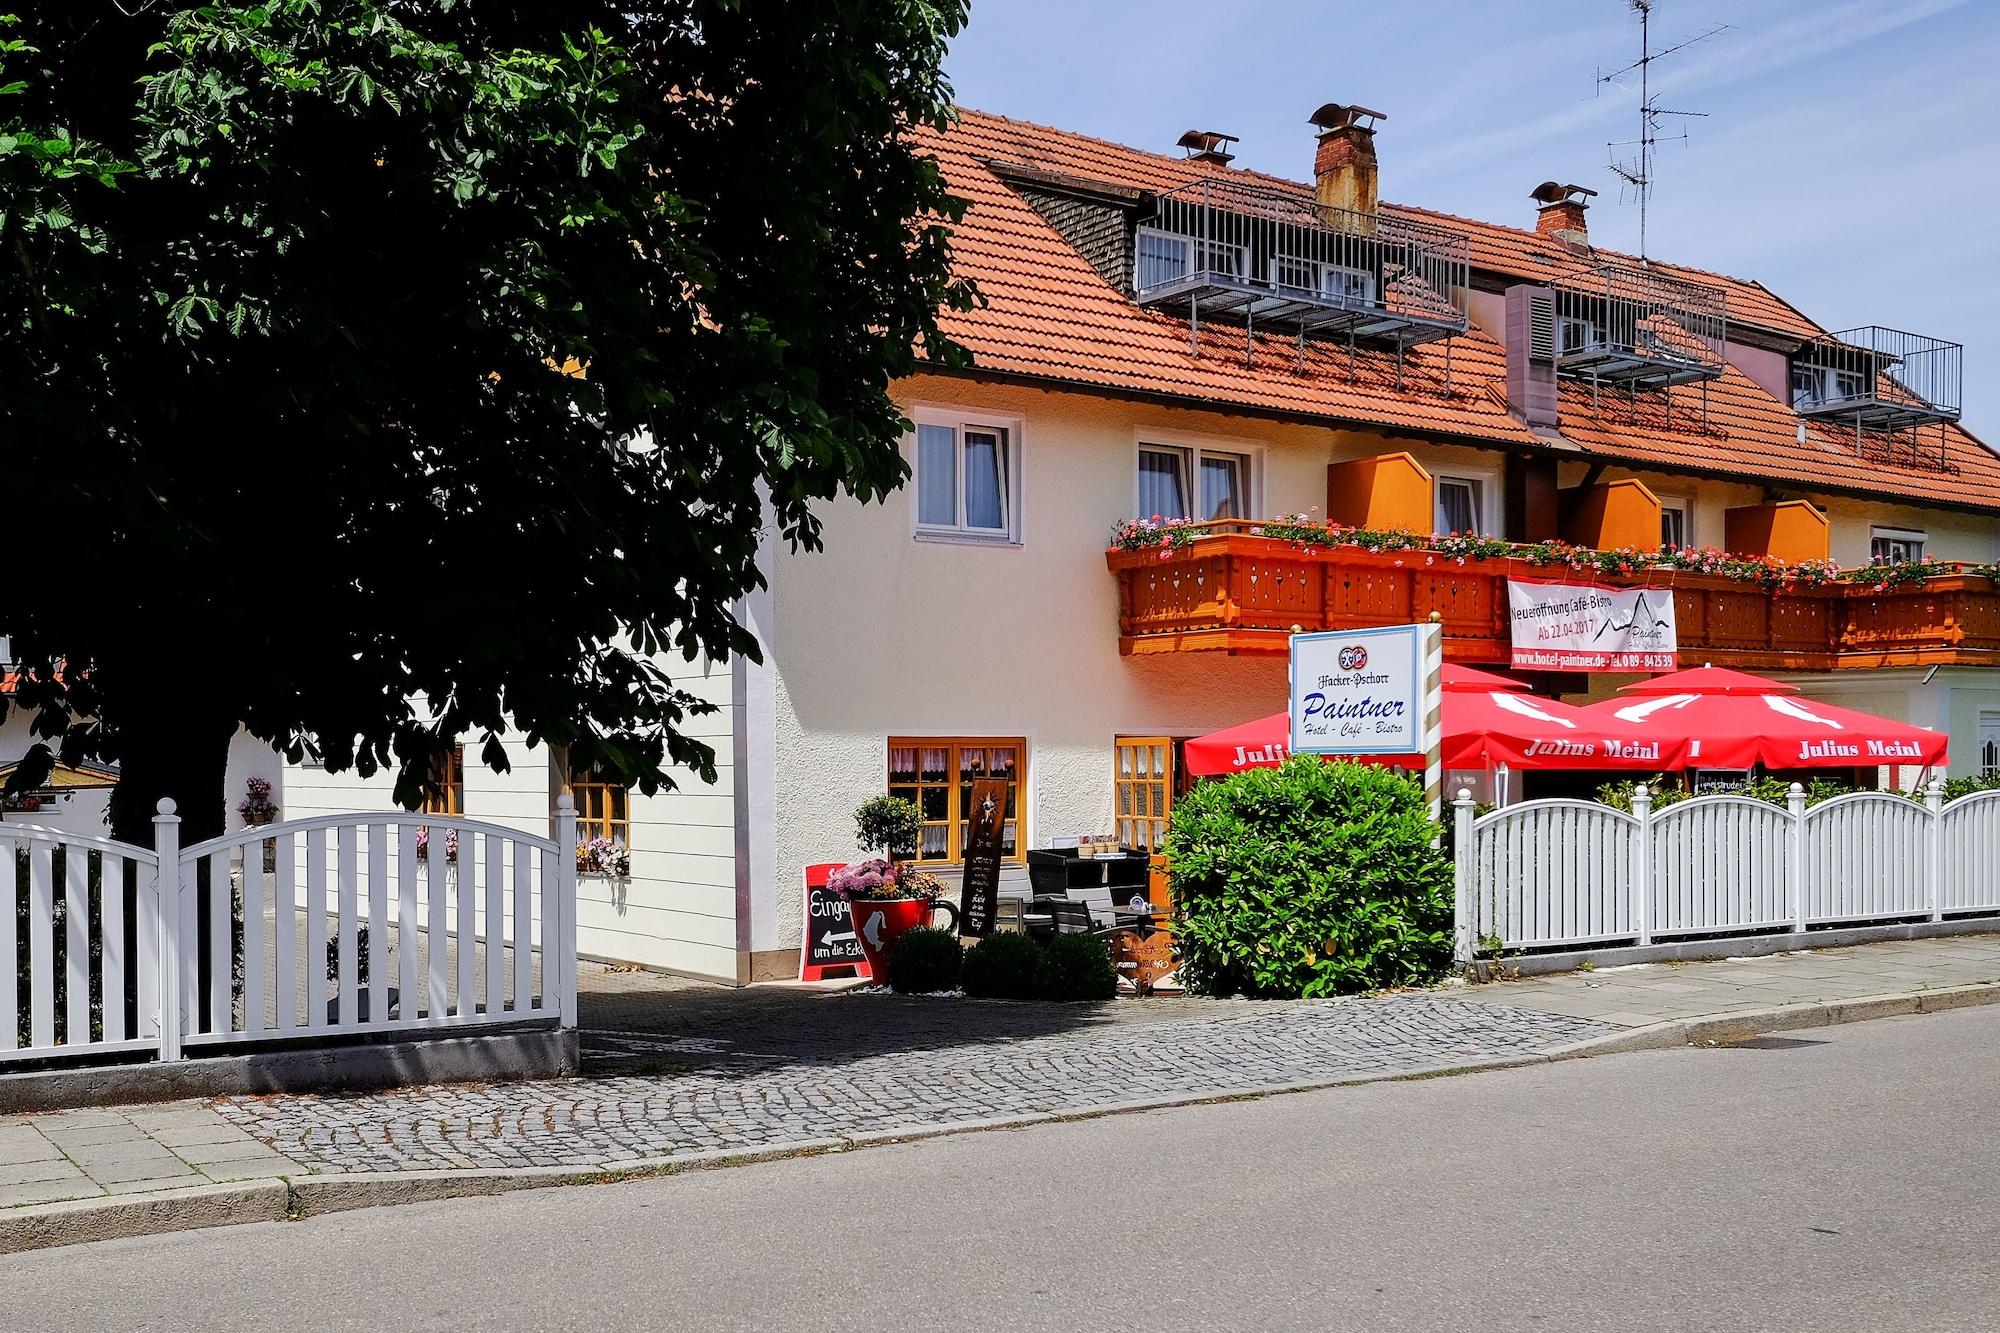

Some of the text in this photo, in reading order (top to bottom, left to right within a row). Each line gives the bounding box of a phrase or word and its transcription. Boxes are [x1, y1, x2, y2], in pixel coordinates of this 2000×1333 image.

[1511, 602, 1570, 621] Neueröffnung
[1538, 618, 1594, 641] Ab 22.04.2017
[1513, 651, 1606, 669] www.hotel-paintner.de
[1318, 672, 1389, 689] Hacker-Pschorr
[1303, 692, 1406, 723] Paintner
[1304, 723, 1328, 736] Hotel
[1340, 722, 1362, 738] Café
[1375, 721, 1403, 734] Bistro
[1524, 739, 1660, 760] Julius Meinl
[1799, 739, 1922, 760] Julius Meinl
[814, 948, 830, 959] um
[831, 943, 845, 956] die
